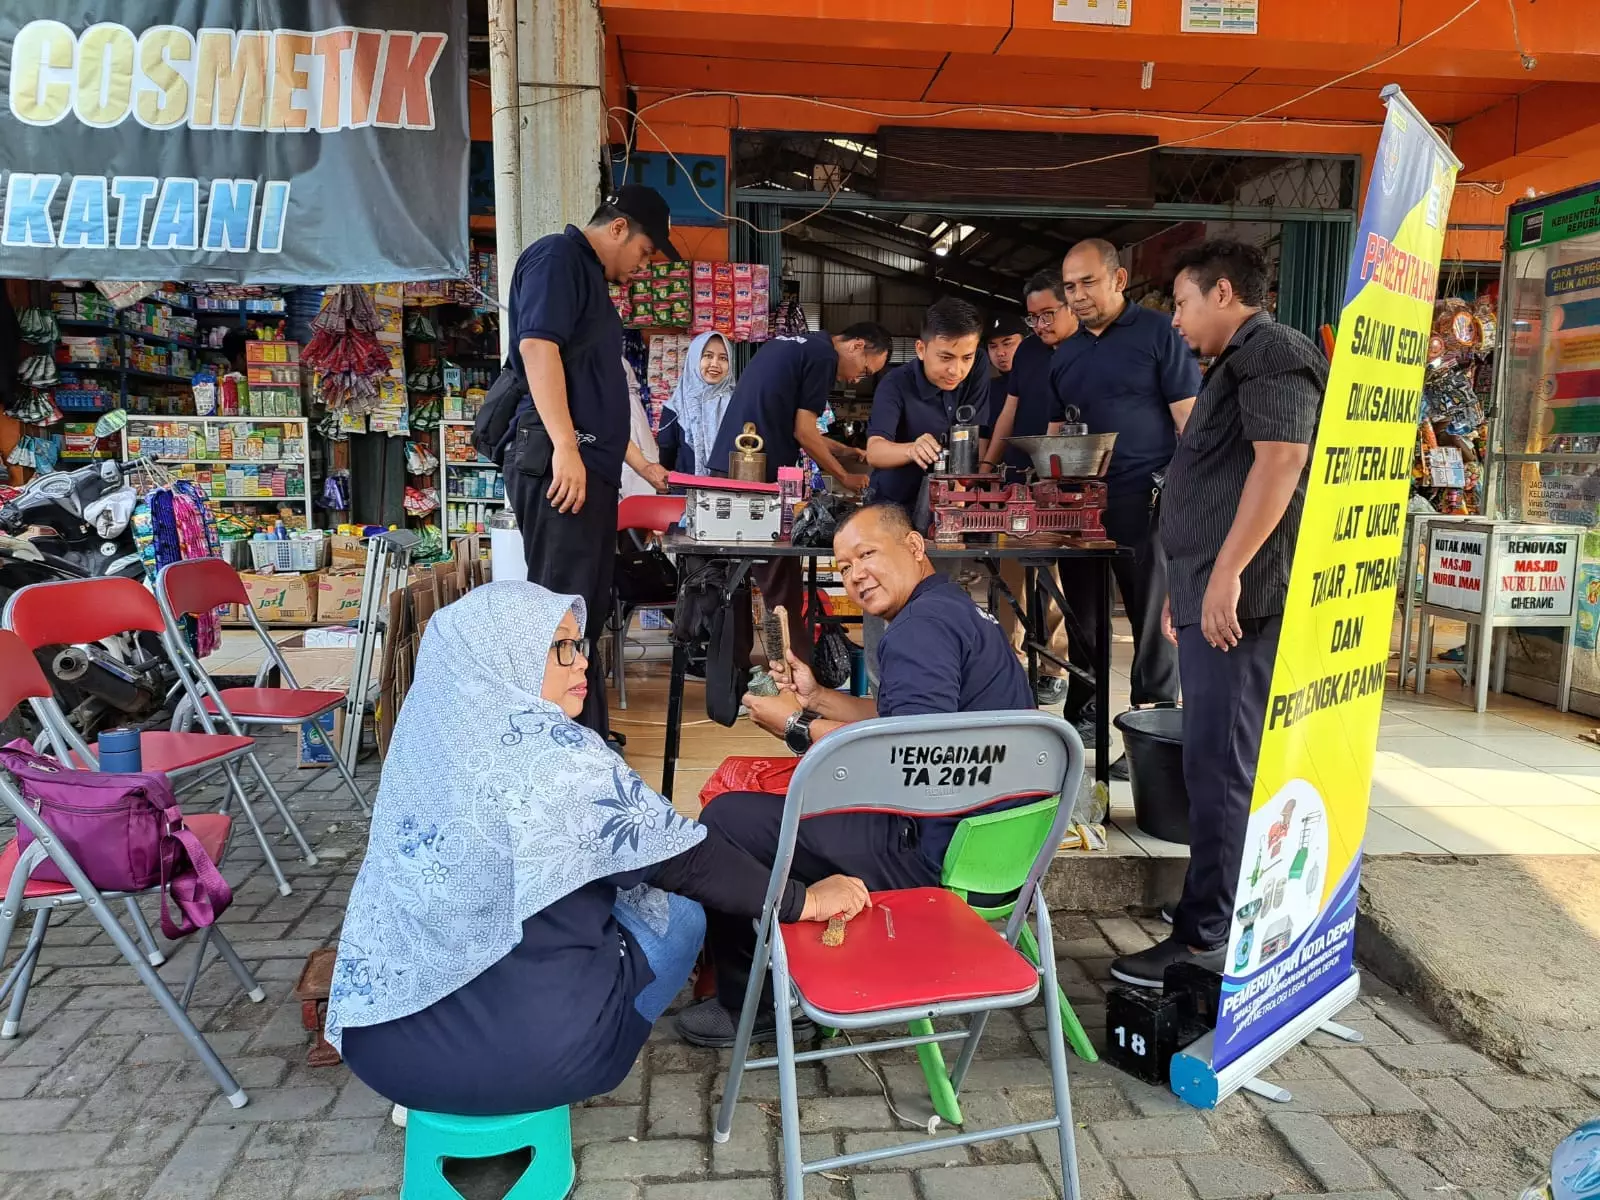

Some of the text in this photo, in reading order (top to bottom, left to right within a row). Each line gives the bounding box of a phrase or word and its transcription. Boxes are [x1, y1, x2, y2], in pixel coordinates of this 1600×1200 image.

[9, 20, 448, 132] COSMETIK
[1, 173, 291, 253] KATANI
[1551, 268, 1572, 280] CARA
[1365, 502, 1401, 538] UKUR,
[1435, 538, 1482, 556] KOTAK AMAL
[1508, 541, 1568, 555] RENOVASI
[1440, 556, 1472, 573] MASJID
[1514, 560, 1559, 573] MASJID
[1432, 571, 1481, 592] NURUL IMAN
[1501, 575, 1567, 592] NURUL IMAN
[1330, 615, 1364, 653] DAN
[889, 744, 1007, 766] PENGADAAN
[901, 765, 993, 787] TA 2014
[1222, 950, 1300, 1018] PEMERINTAH
[1300, 934, 1326, 965] KOTA
[1114, 1025, 1147, 1056] 18
